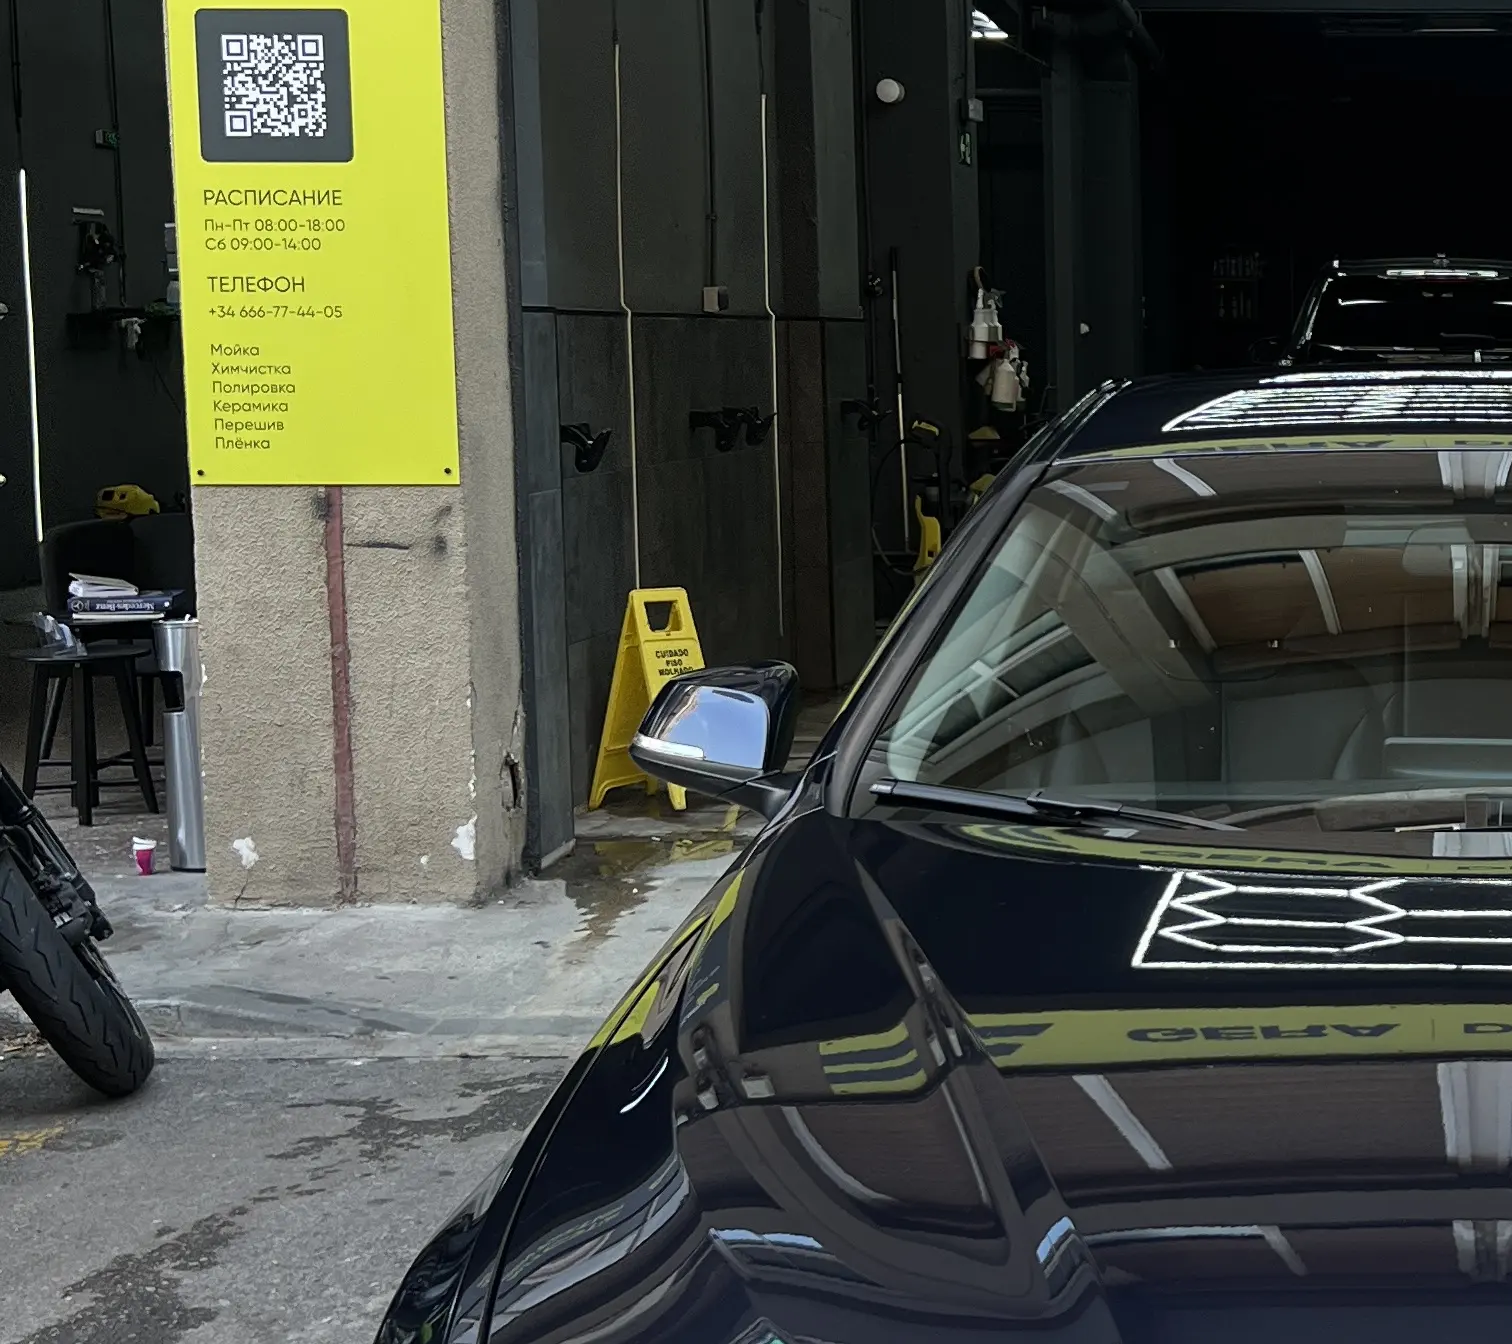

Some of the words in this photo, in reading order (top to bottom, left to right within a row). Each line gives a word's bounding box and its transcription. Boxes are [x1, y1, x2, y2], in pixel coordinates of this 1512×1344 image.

[203, 189, 343, 207] РАСПИСАНИЕ
[204, 219, 250, 232] Пн-Пт
[254, 219, 346, 232] 08:00-18:00
[205, 238, 227, 251] Сб
[230, 238, 322, 251] 09:00-14:00
[207, 276, 306, 294] ТЕЛЕФОН
[208, 306, 236, 319] +34
[239, 306, 343, 319] 666-77-44-05
[210, 343, 260, 357] Мойка
[211, 362, 291, 375] Химчистка
[212, 381, 296, 396] Полировка
[213, 400, 289, 414] Керамика
[214, 418, 285, 433] Перешив
[215, 436, 271, 450] Плёнка
[655, 649, 689, 658] CUIDADO
